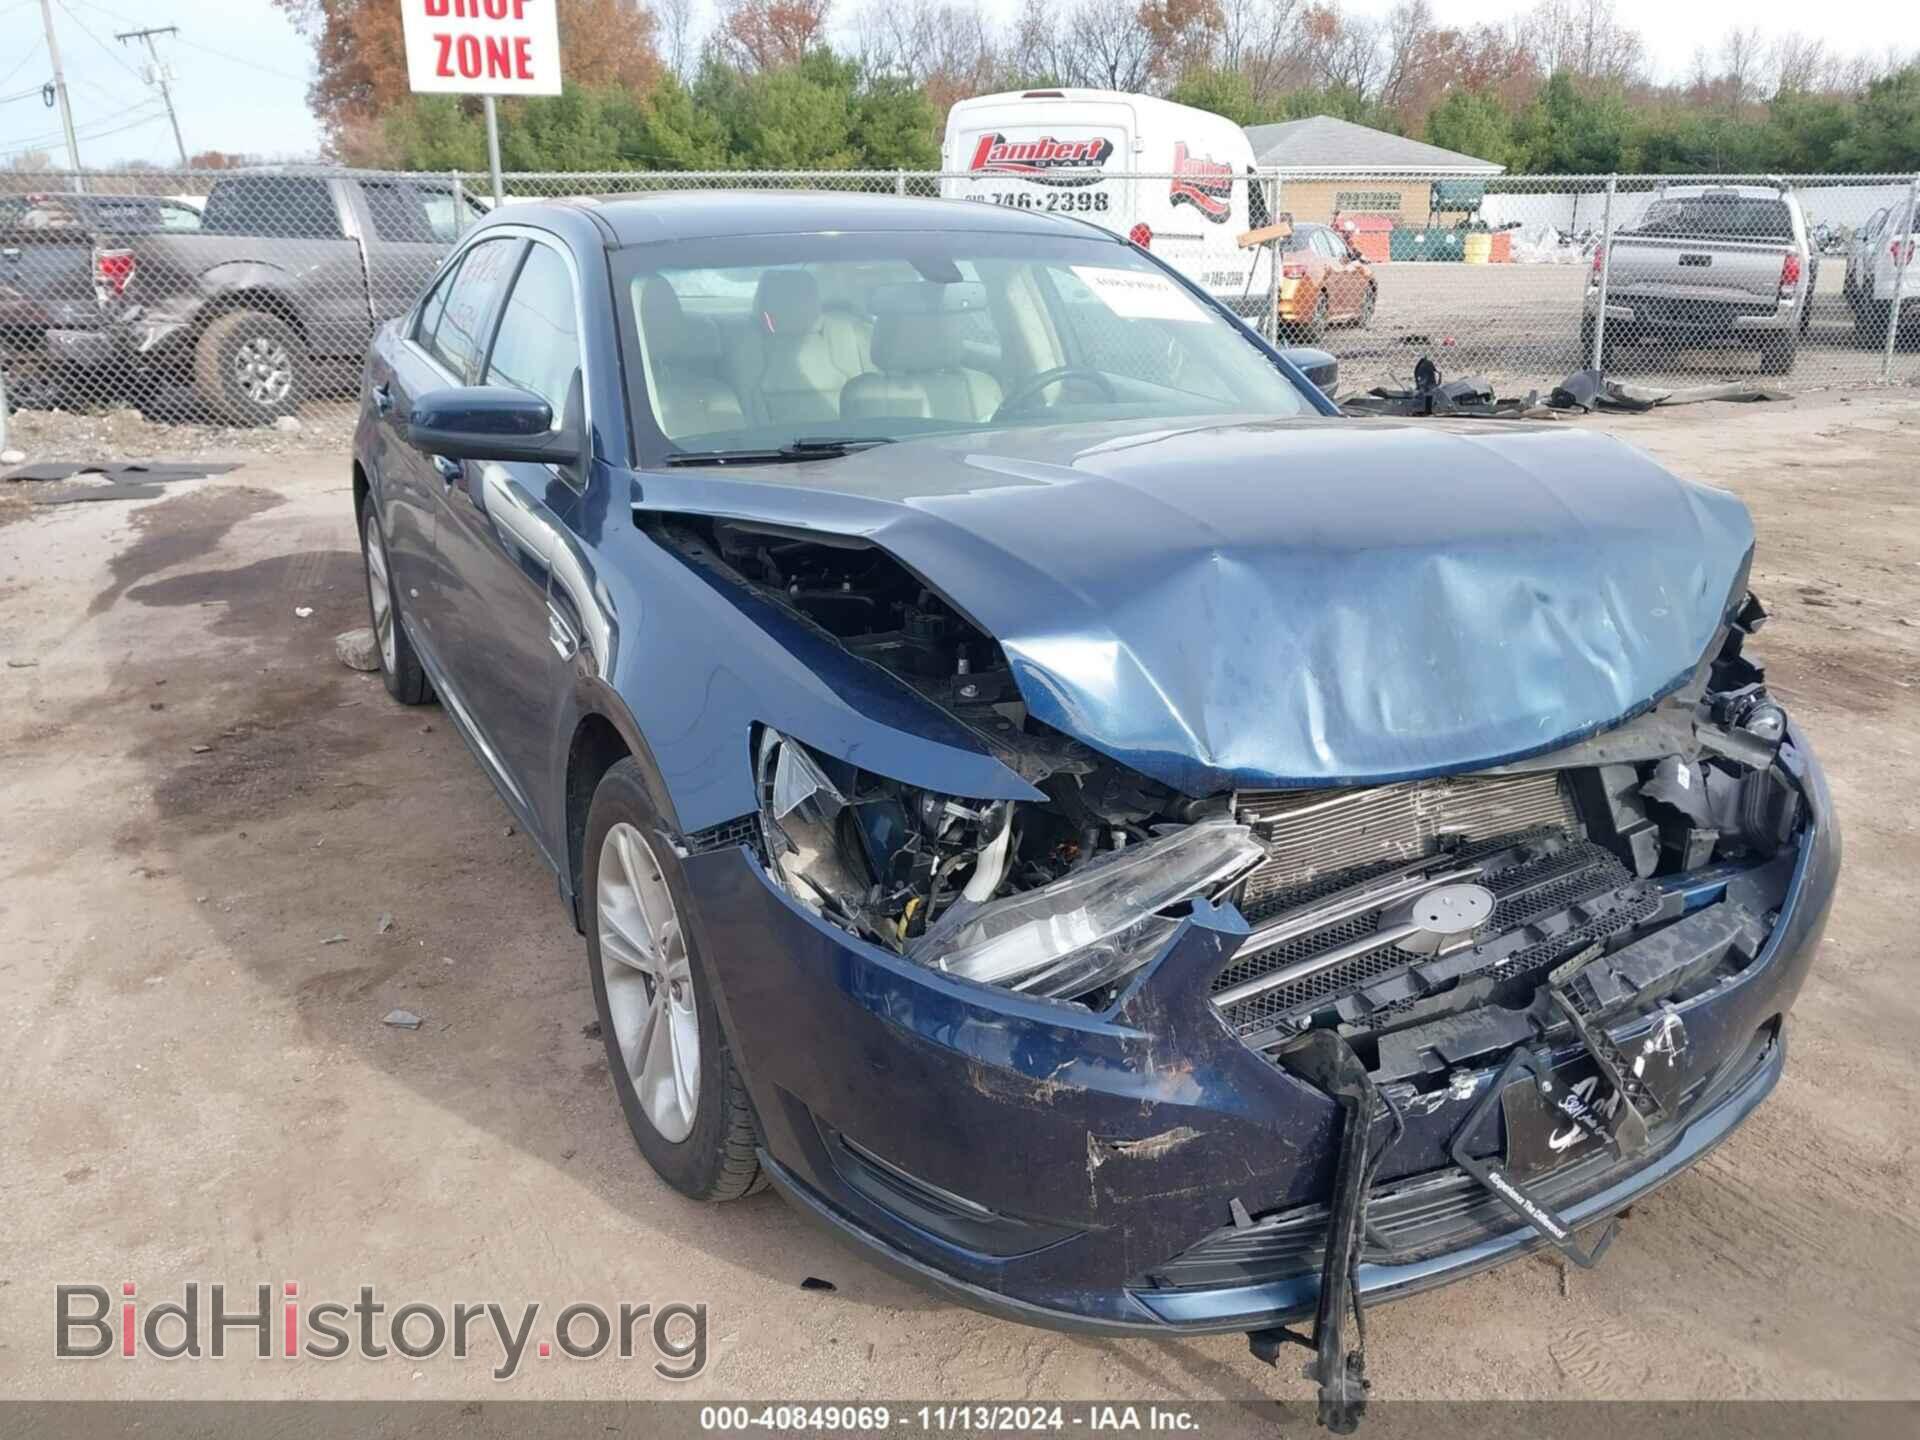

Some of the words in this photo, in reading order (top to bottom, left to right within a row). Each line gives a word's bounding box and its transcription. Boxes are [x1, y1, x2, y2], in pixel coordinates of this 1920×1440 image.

[433, 33, 535, 80] ZONE
[970, 132, 1114, 171] Lambert
[1522, 1199, 1536, 1216] The
